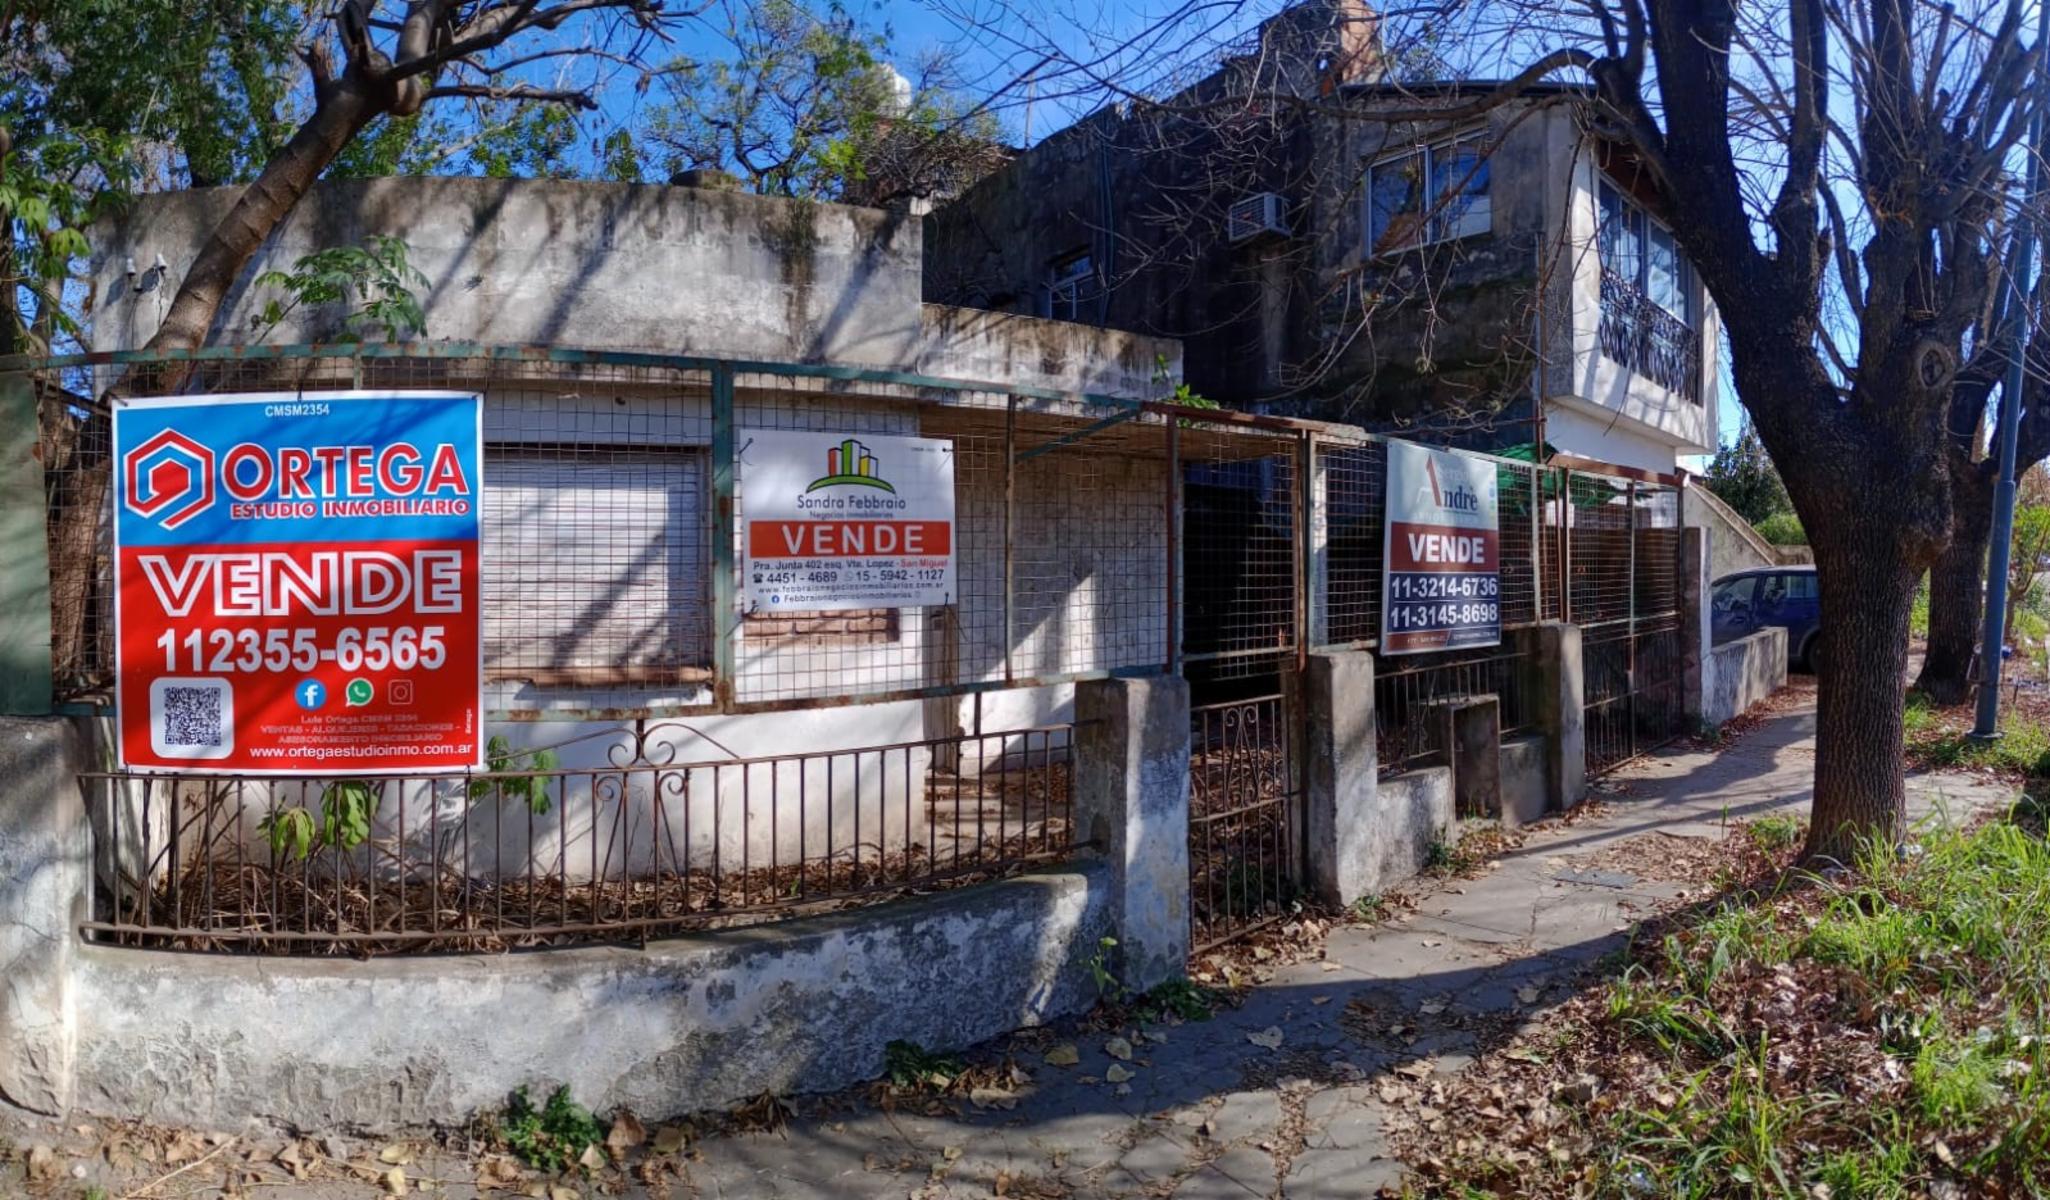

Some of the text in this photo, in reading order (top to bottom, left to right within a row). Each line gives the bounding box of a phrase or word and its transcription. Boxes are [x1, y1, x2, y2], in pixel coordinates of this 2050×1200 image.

[264, 404, 330, 418] CMSM2354
[221, 443, 470, 501] ORTEGA
[230, 498, 470, 519] ESTUDIO INMOBILIARIO
[797, 494, 906, 509] Sandra Febbraio
[781, 524, 924, 555] VENDE
[1408, 532, 1485, 564] VENDE
[775, 561, 803, 571] Junta
[804, 560, 823, 569] 402
[900, 559, 917, 568] San
[919, 558, 948, 569] Miguel
[856, 570, 871, 582] 15
[880, 570, 908, 581] 5942
[917, 569, 945, 580] 1127
[137, 550, 462, 617] VENDE
[766, 572, 797, 584] 4451
[807, 571, 838, 583] 4689
[1391, 576, 1498, 599] 11-3214-6736
[1390, 603, 1498, 628] 11-3145-8698
[156, 626, 446, 673] 112355-6565
[249, 743, 472, 760] www.ortegaestudioinmo.com.ar
